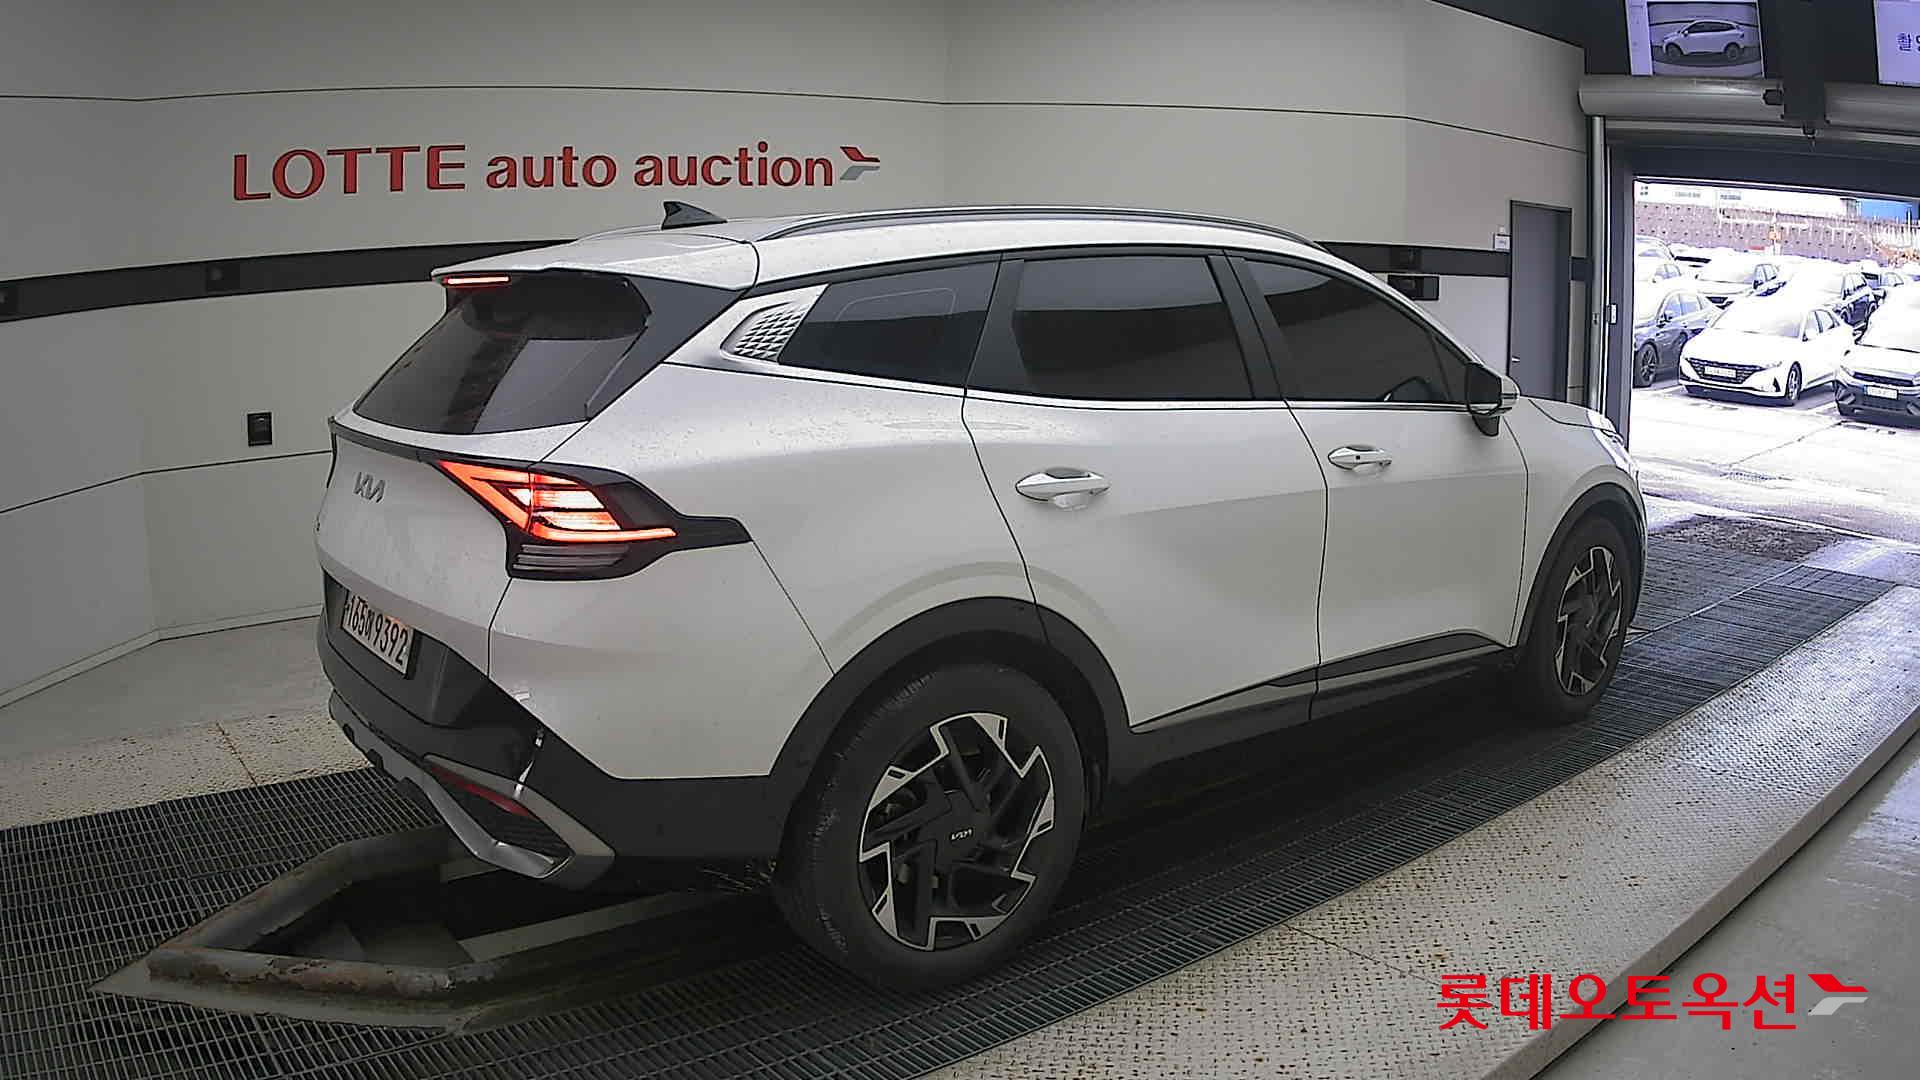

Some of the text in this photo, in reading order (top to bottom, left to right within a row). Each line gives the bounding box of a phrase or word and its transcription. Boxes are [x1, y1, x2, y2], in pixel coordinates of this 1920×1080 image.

[233, 141, 833, 200] LOTTE auto auction
[353, 471, 385, 503] KIA
